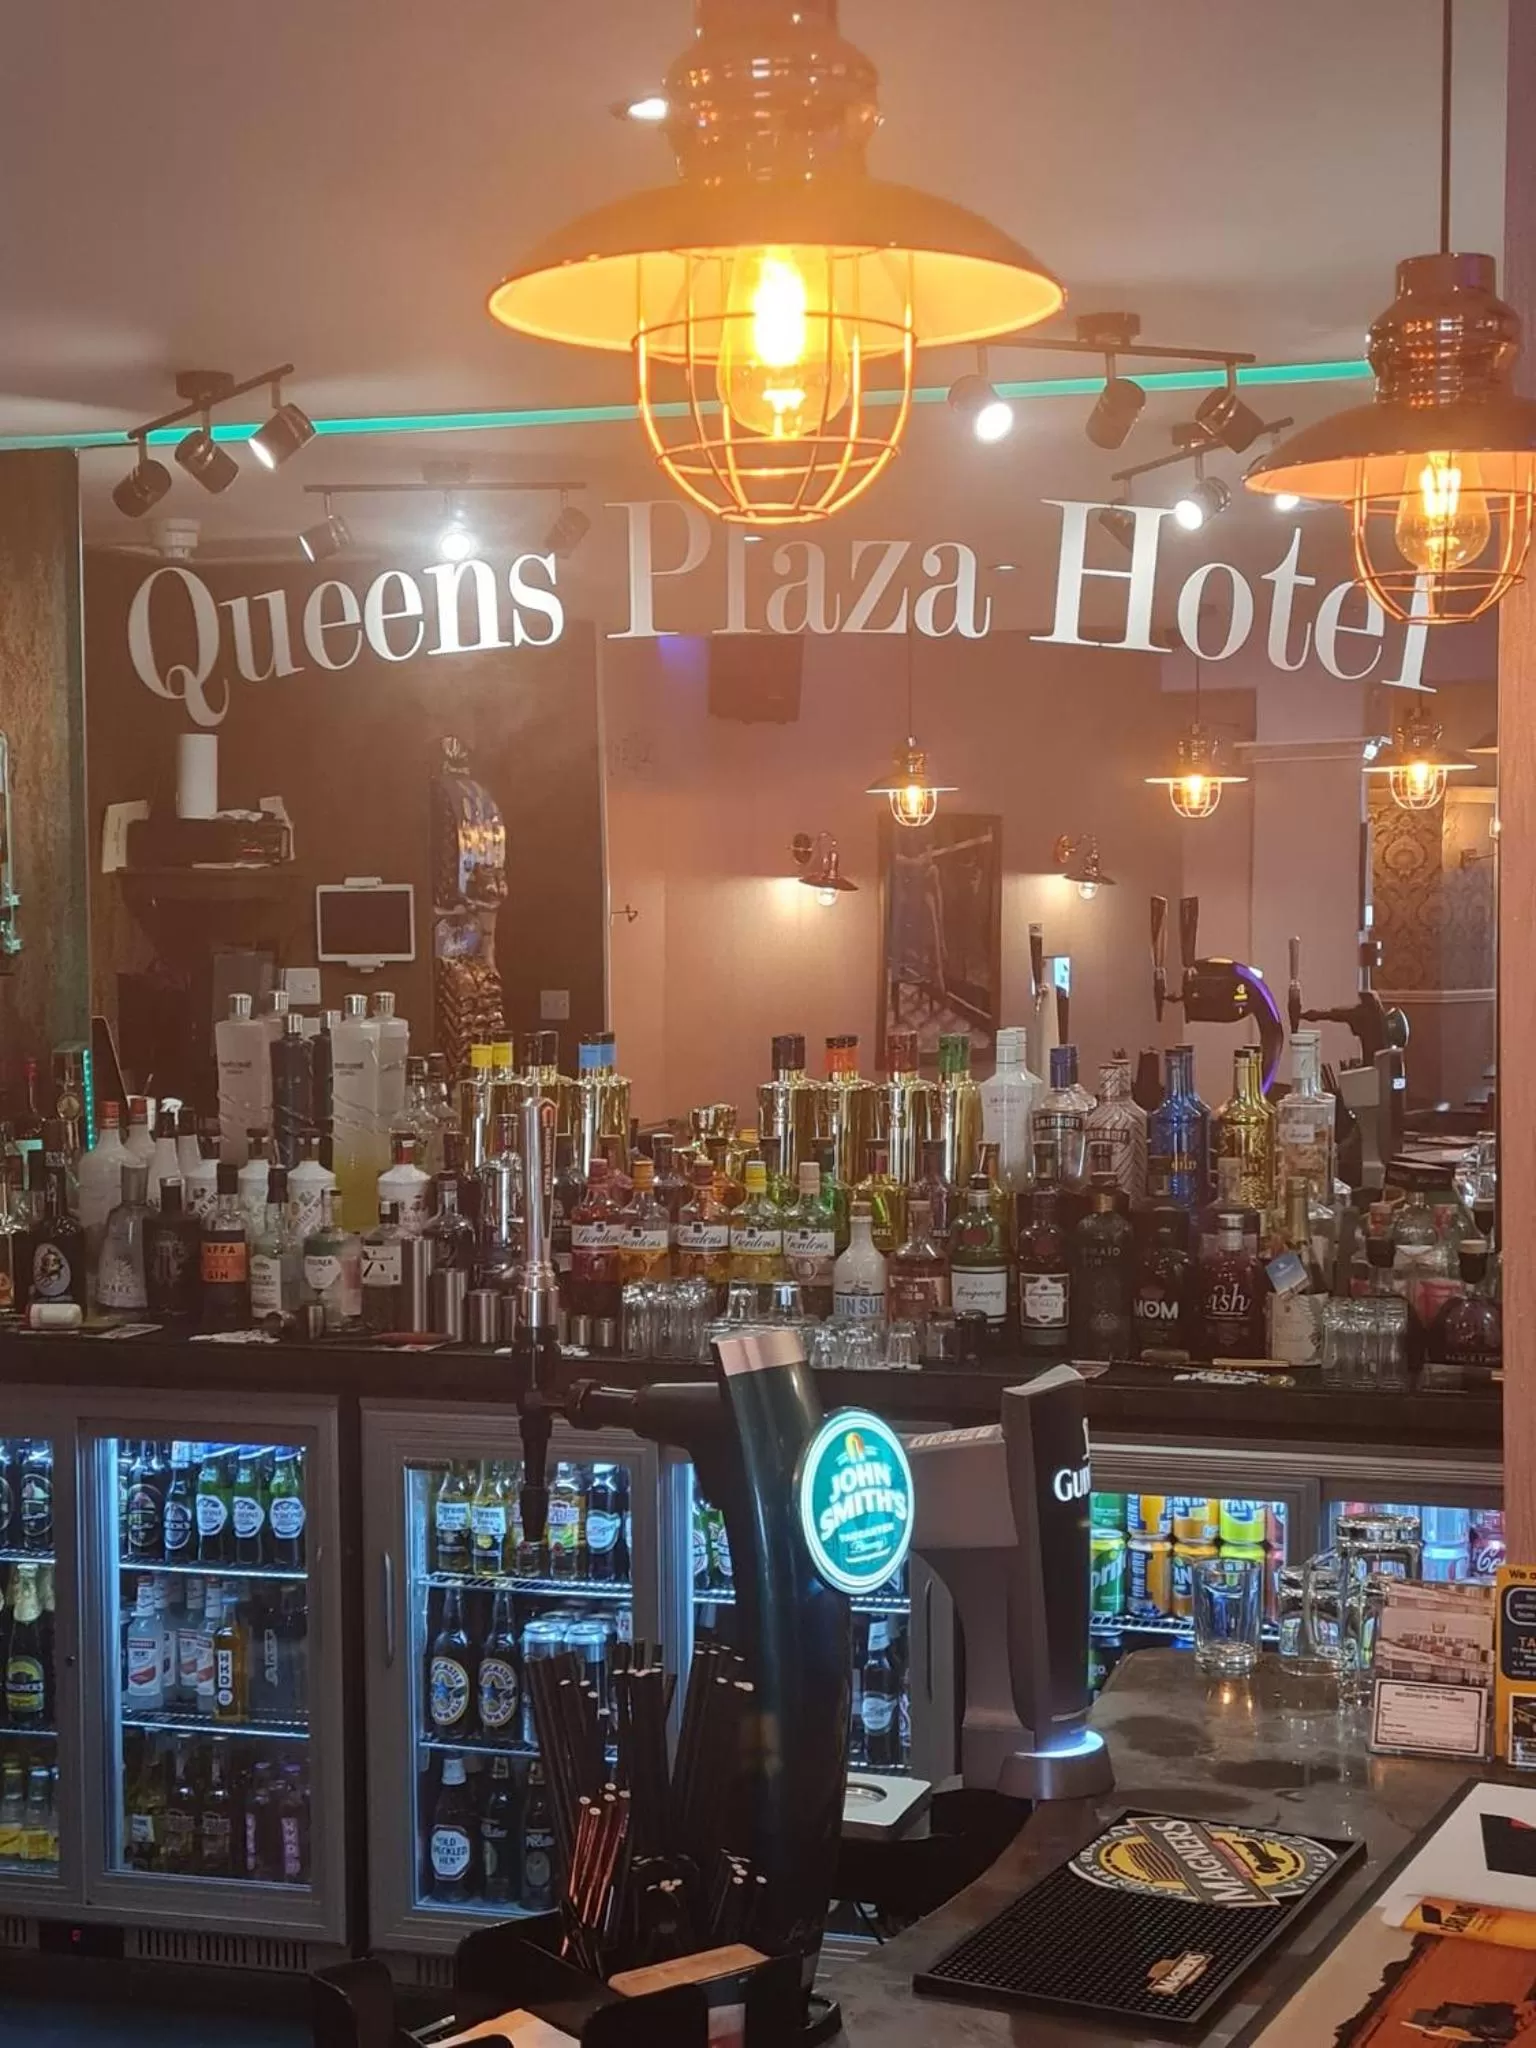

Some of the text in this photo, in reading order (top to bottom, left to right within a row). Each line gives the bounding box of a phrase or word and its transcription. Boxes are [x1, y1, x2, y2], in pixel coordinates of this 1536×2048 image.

[127, 498, 1438, 727] Queens Plaza Hotel
[1134, 1300, 1179, 1320] MOM
[828, 1461, 893, 1504] JOHN
[819, 1487, 909, 1543] SMITH'S
[1509, 1569, 1527, 1579] We
[1152, 1820, 1257, 1902] MAGNERS
